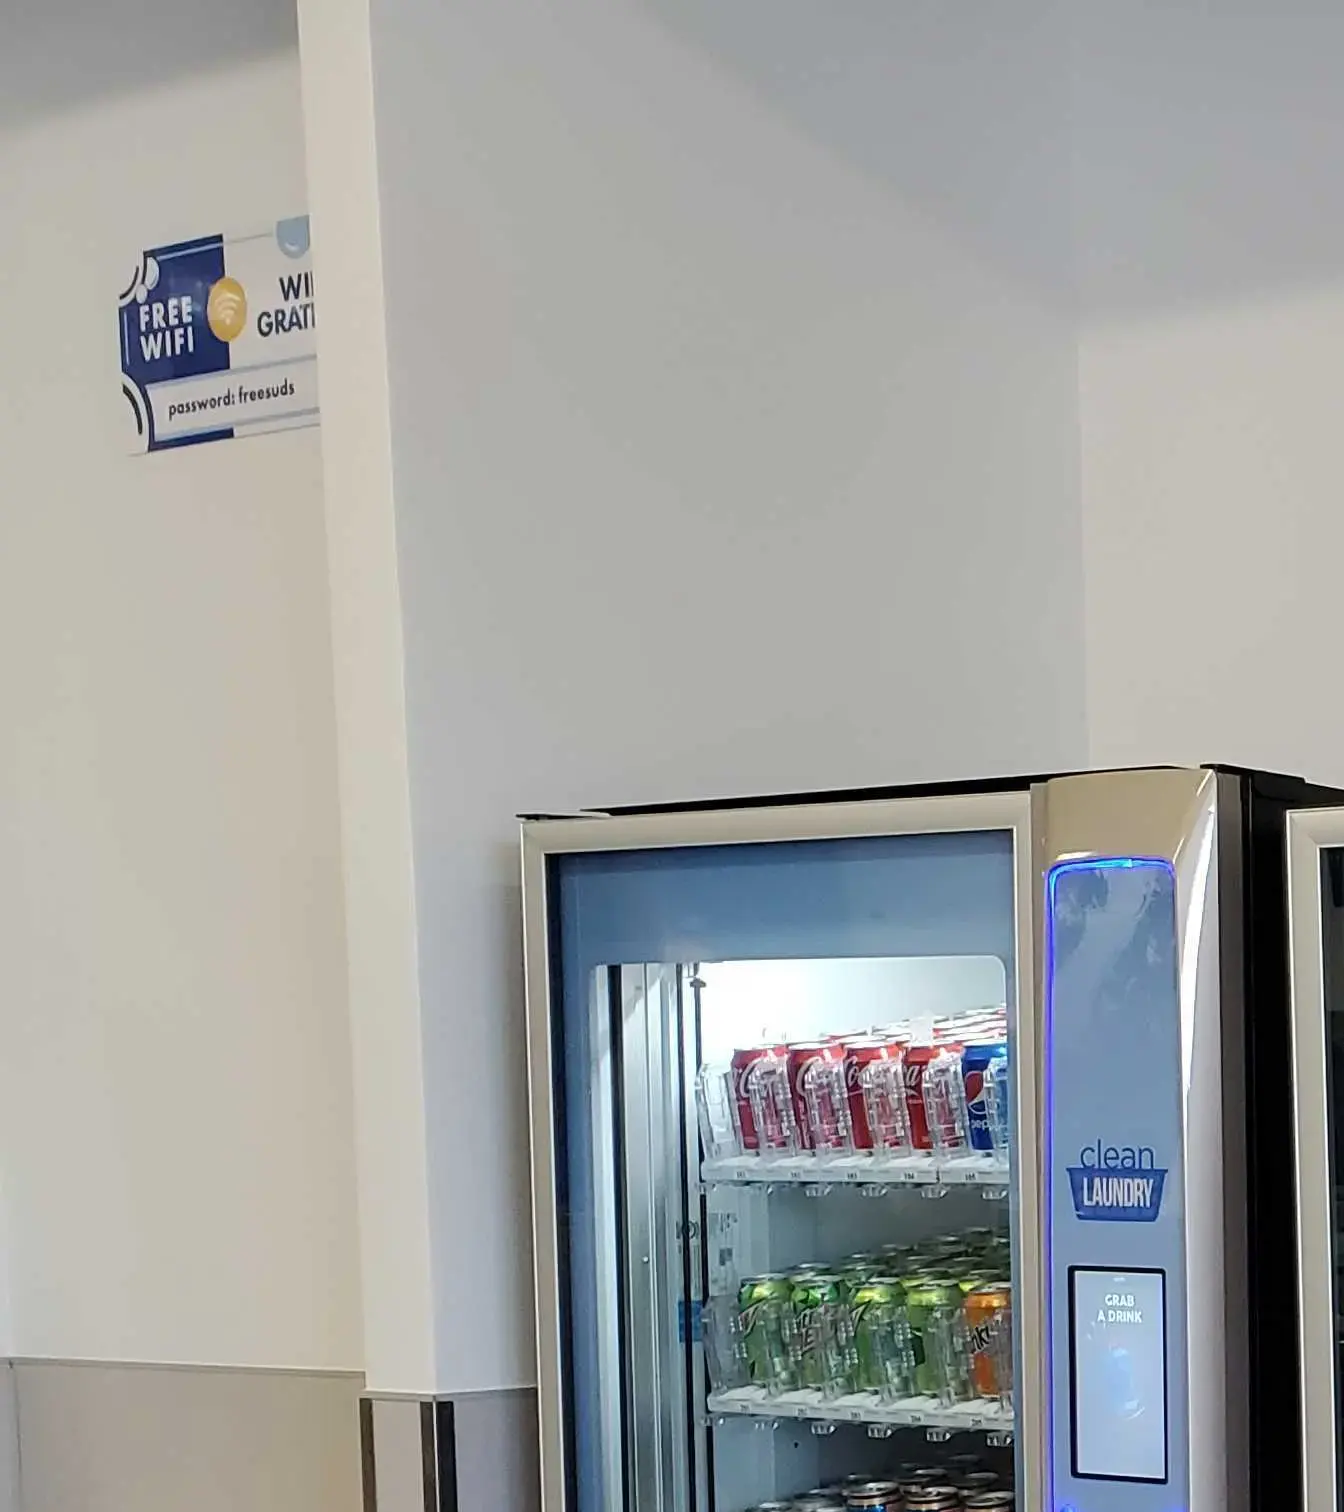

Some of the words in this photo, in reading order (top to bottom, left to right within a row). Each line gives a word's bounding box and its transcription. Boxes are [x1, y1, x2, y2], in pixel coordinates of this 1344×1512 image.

[139, 295, 193, 332] FREE
[140, 326, 194, 362] WIFI
[169, 387, 236, 420] password:
[239, 378, 295, 403] freesuds
[1080, 1139, 1154, 1170] clean
[1083, 1177, 1153, 1208] LAUNDRY
[1105, 1294, 1135, 1307] GRAB
[1097, 1310, 1106, 1322] A
[1107, 1310, 1142, 1323] DRINK
